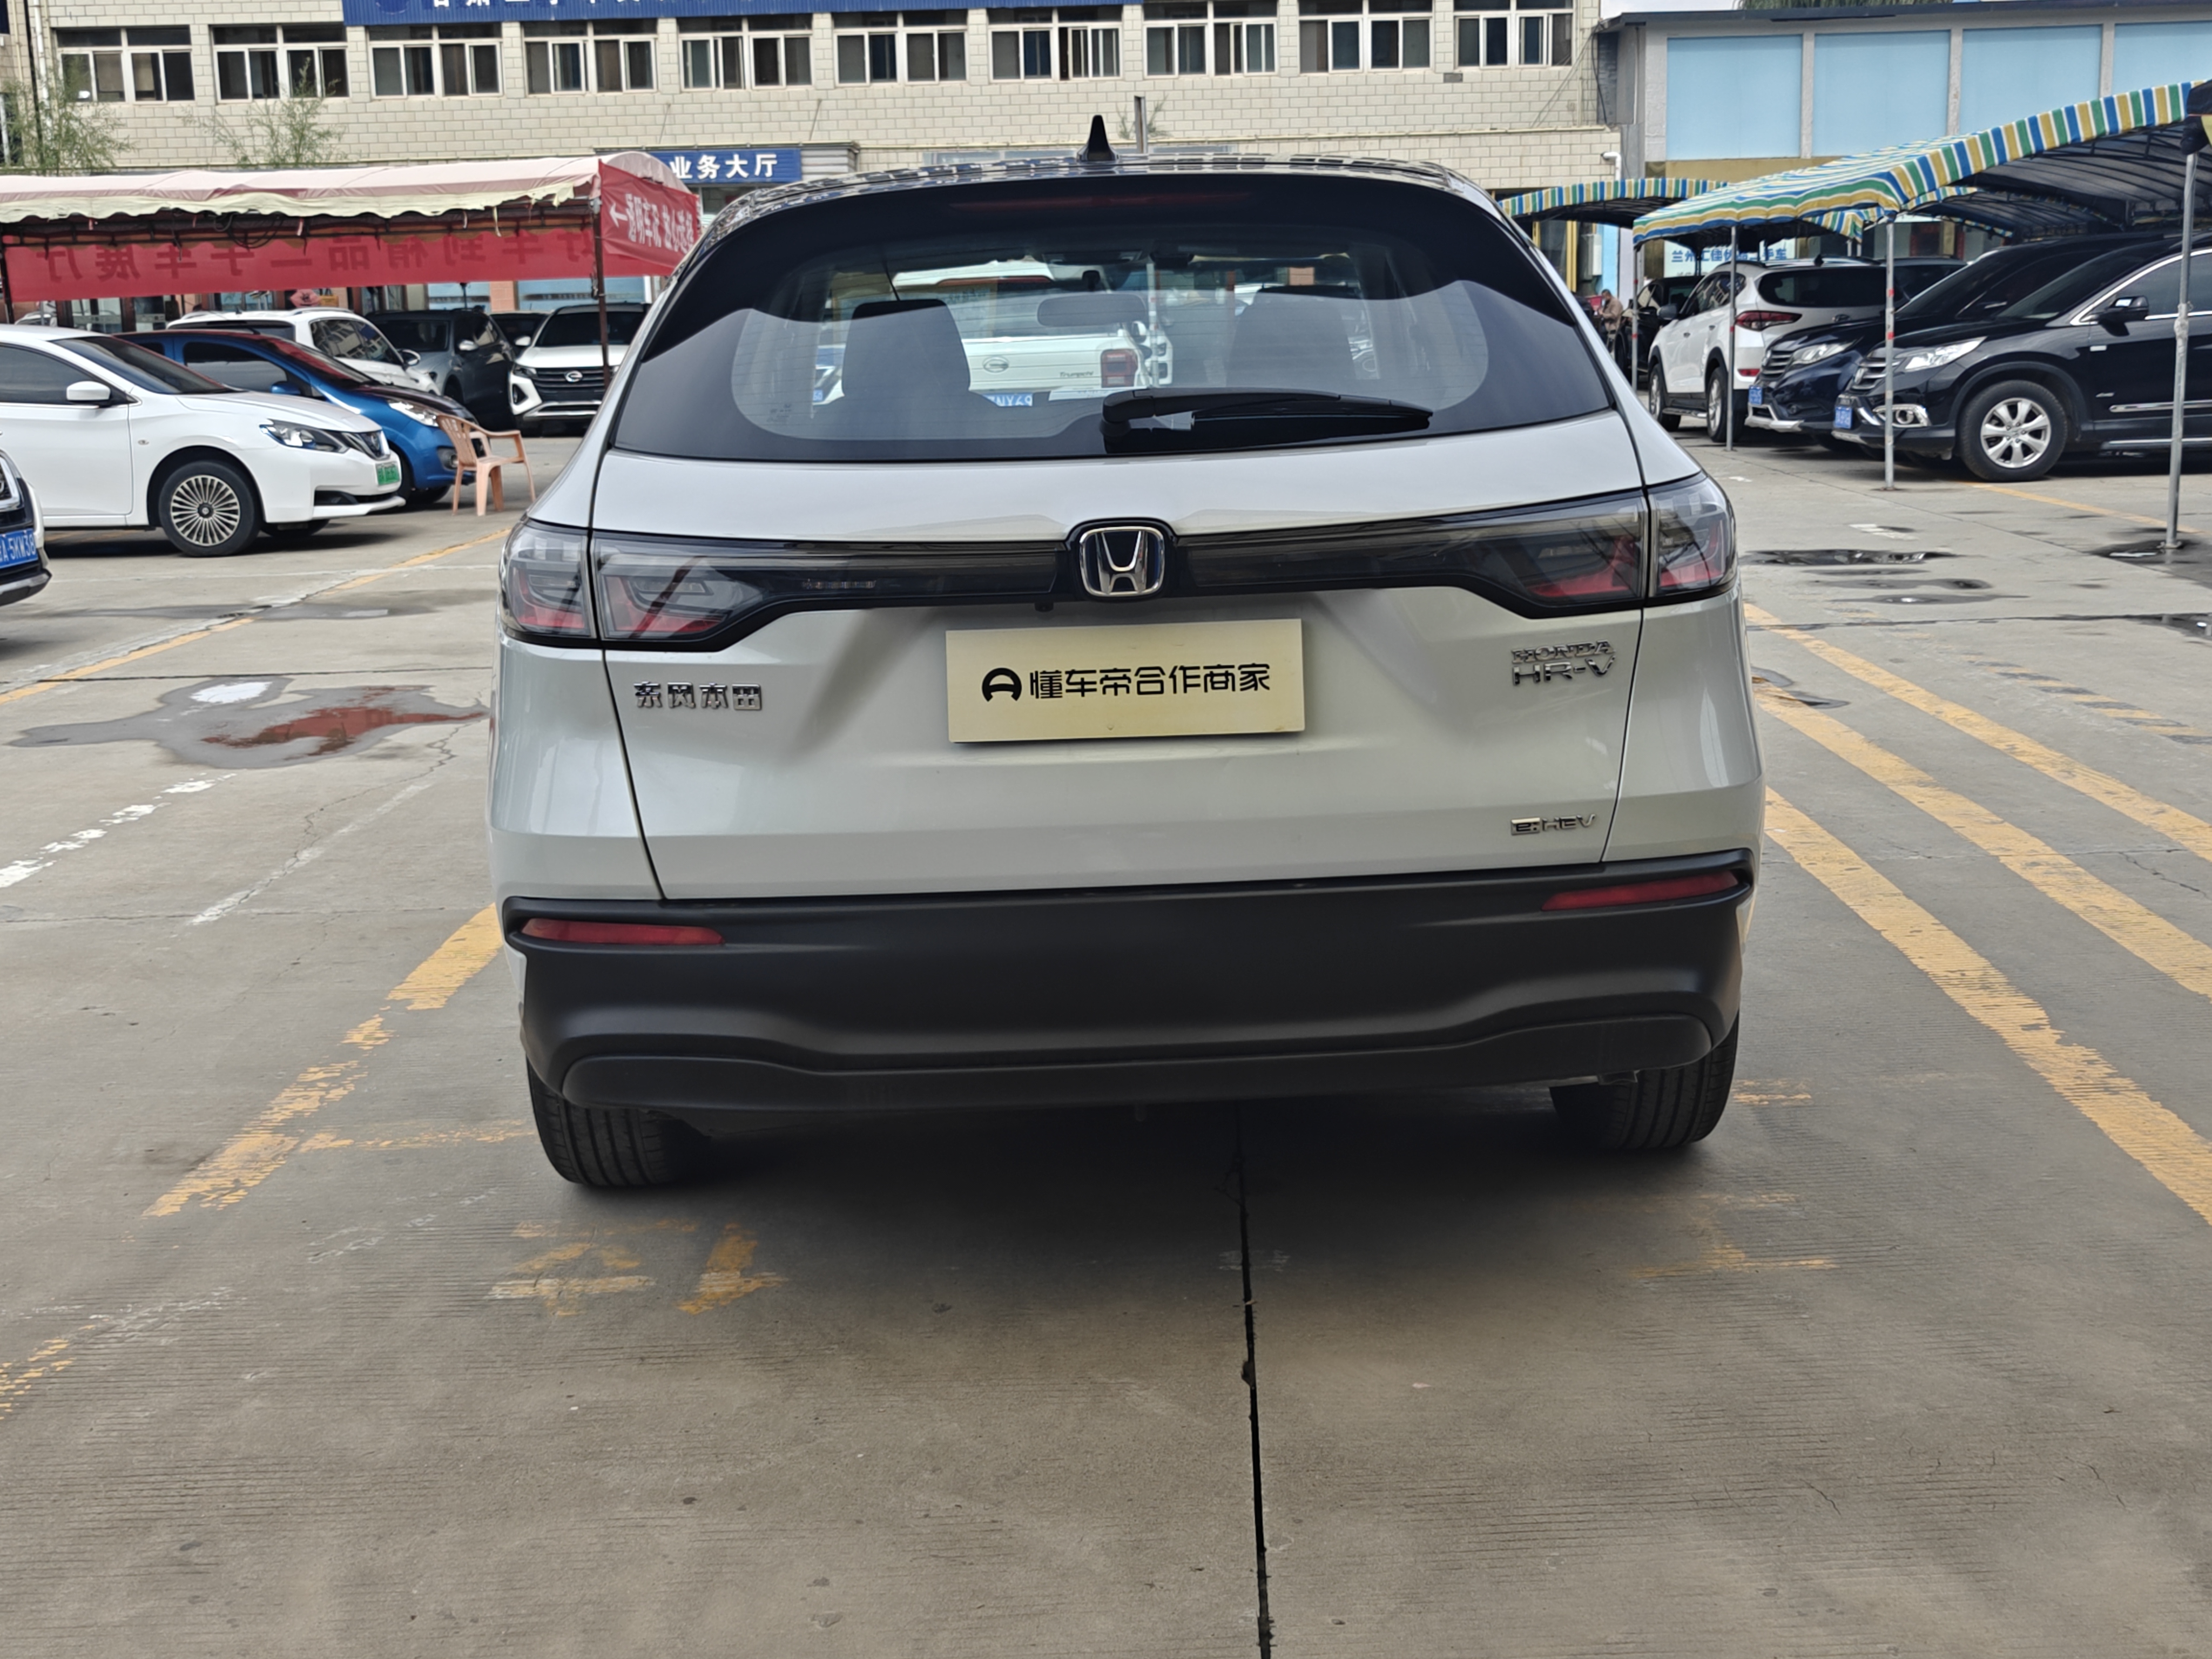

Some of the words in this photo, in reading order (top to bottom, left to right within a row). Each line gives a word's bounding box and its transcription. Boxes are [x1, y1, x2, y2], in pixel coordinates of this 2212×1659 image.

[670, 153, 778, 179] 业务大厅
[1512, 639, 1616, 664] HONDA
[1029, 663, 1270, 699] 懂车帝合作商家
[1513, 655, 1616, 685] HR-V
[633, 681, 763, 711] 东风本田
